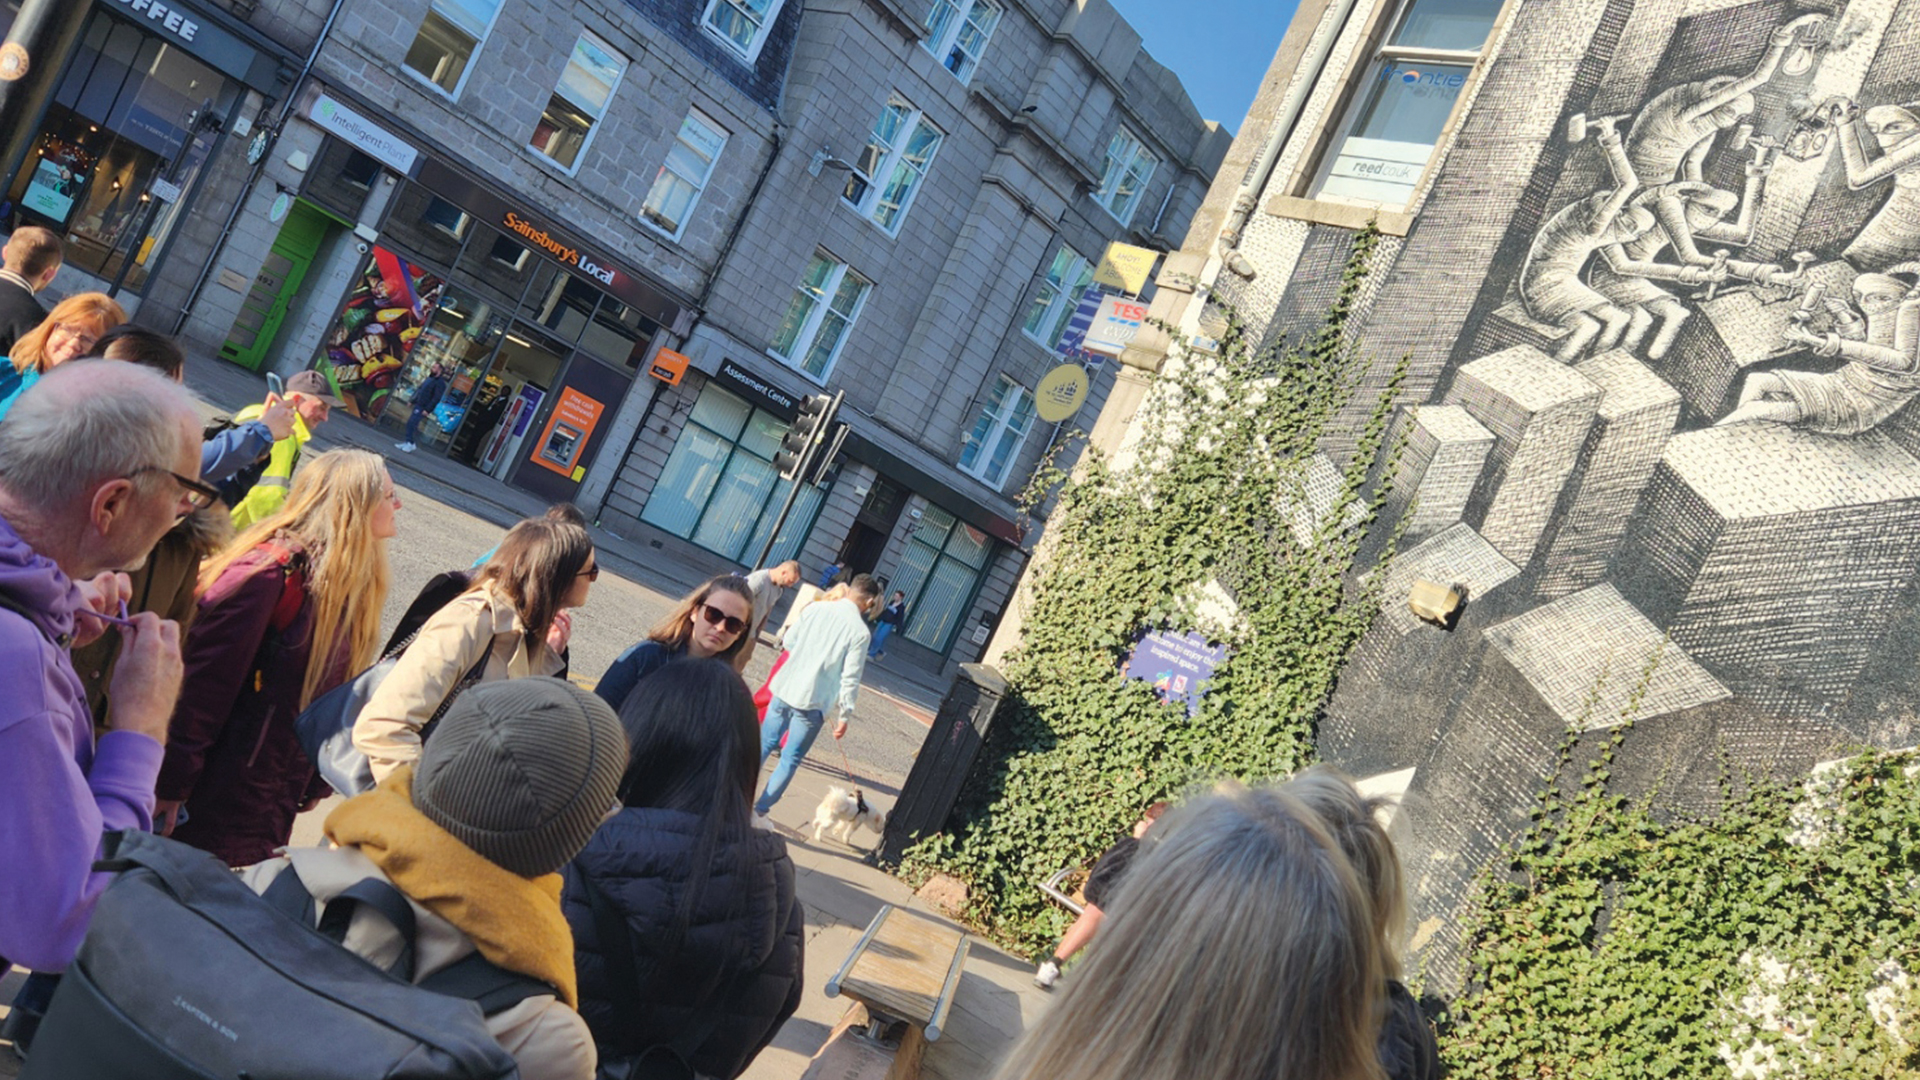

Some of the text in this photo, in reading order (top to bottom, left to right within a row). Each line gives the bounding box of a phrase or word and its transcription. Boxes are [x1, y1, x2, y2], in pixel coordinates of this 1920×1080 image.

[1380, 65, 1466, 87] frontie
[331, 111, 407, 163] Intelligent Plant
[503, 211, 616, 285] Sainsbury's Local
[1112, 301, 1149, 320] TES
[723, 364, 792, 409] Assessment Centre
